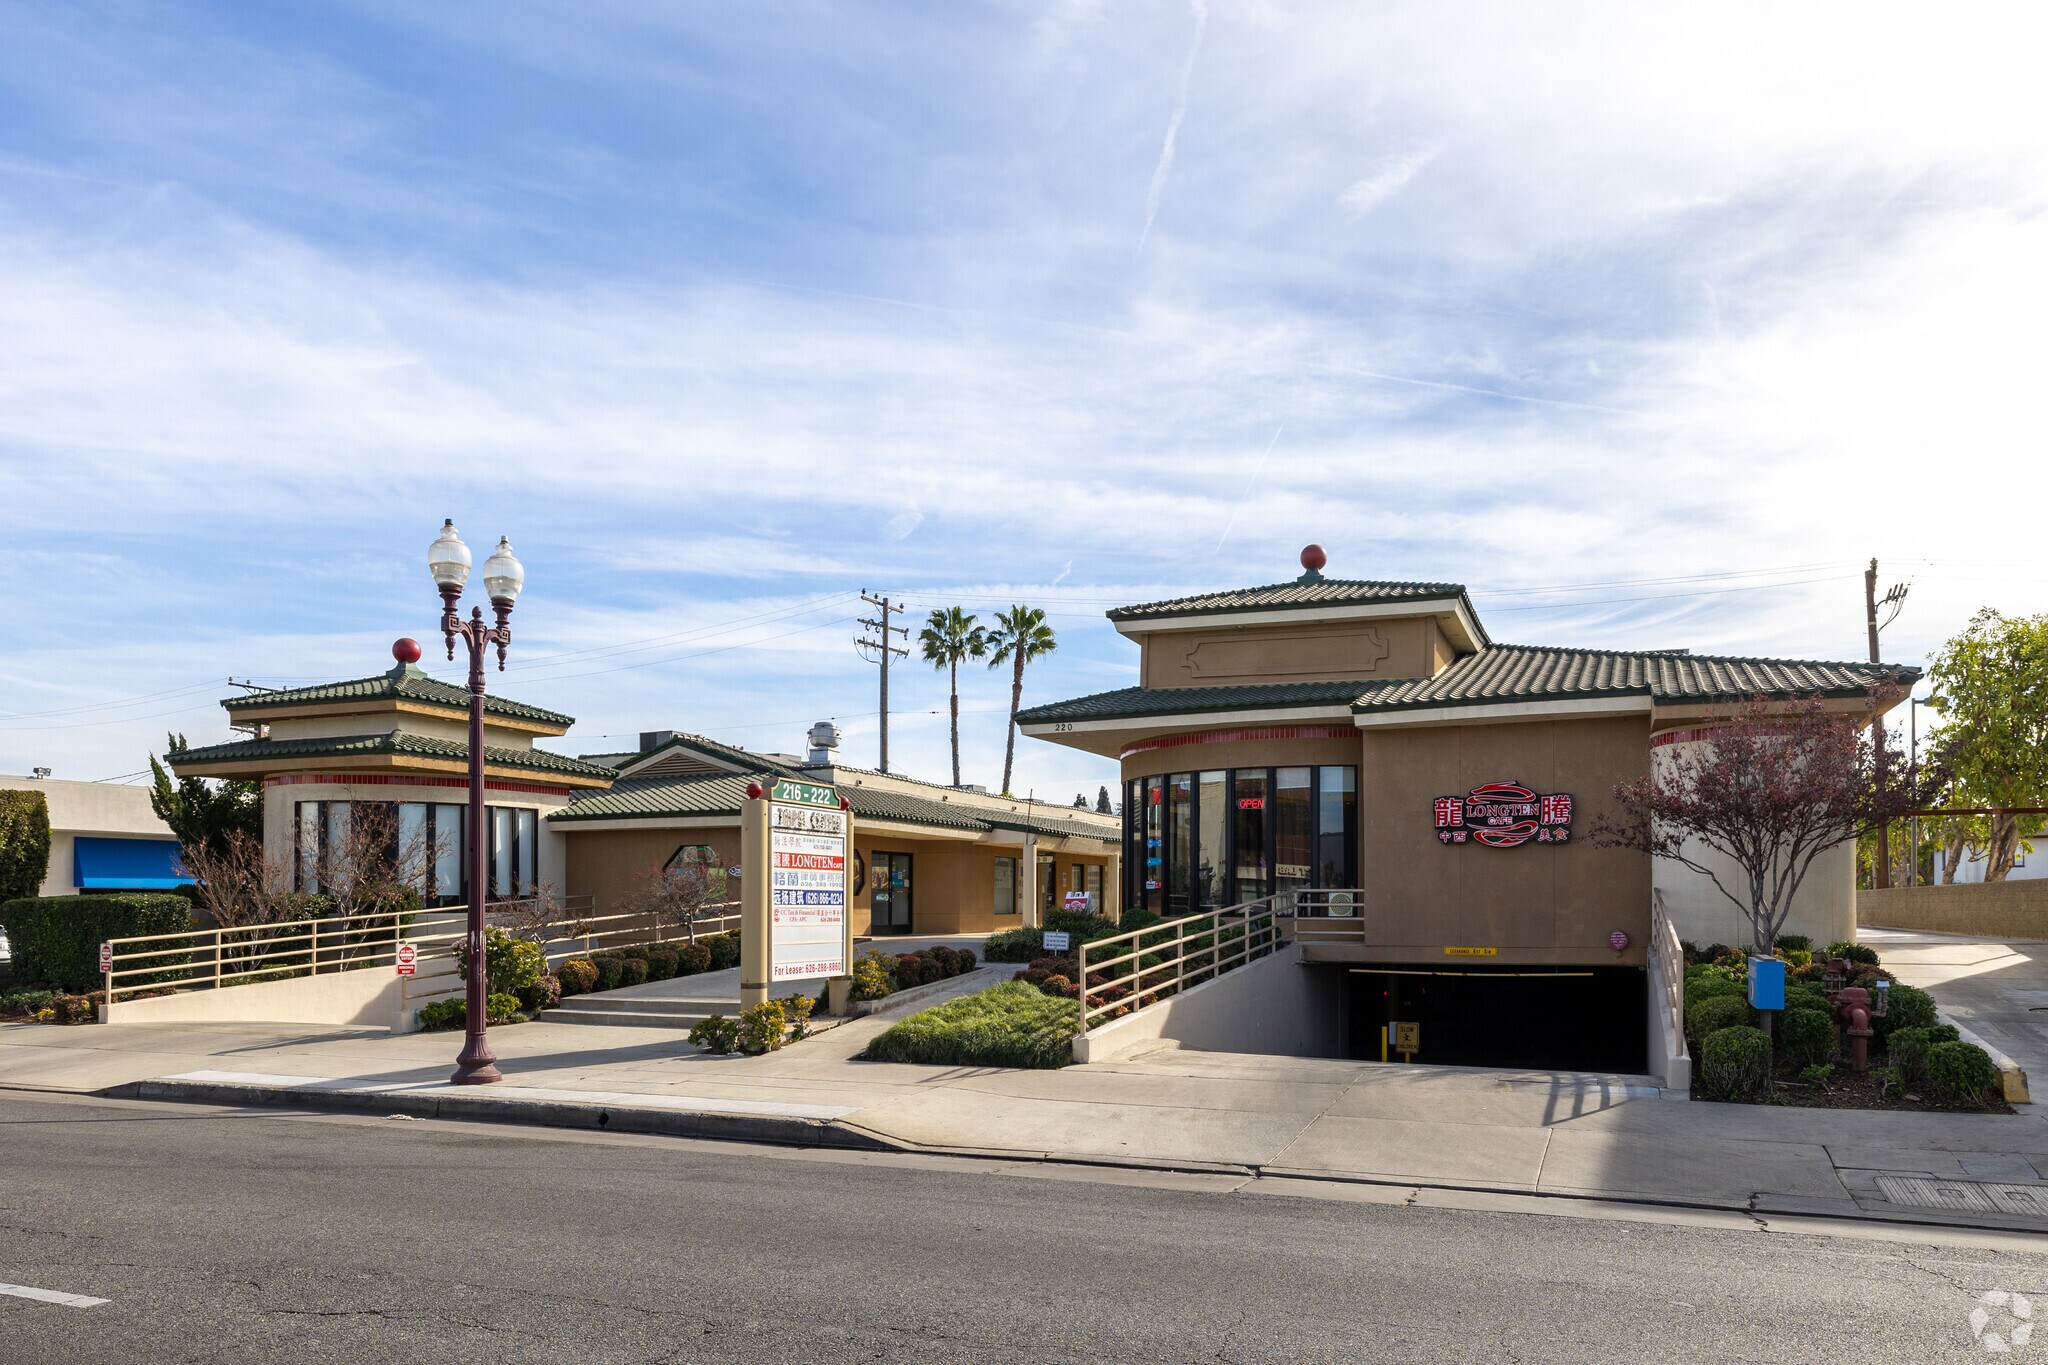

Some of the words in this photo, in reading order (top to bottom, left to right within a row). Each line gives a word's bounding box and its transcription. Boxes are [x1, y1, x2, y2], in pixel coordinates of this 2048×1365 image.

[1055, 723, 1073, 732] 220
[782, 783, 801, 800] 216
[811, 787, 830, 805] 222
[1239, 799, 1265, 809] OPEN
[1466, 803, 1540, 818] LONGTEN
[1540, 794, 1572, 825] 騰
[1434, 797, 1464, 827] 龍
[1487, 816, 1513, 825] CAFE
[1439, 830, 1468, 843] 中西
[1538, 827, 1569, 842] 美食
[791, 854, 834, 869] LONGTEN
[774, 966, 784, 976] For
[785, 965, 804, 975] Lease:
